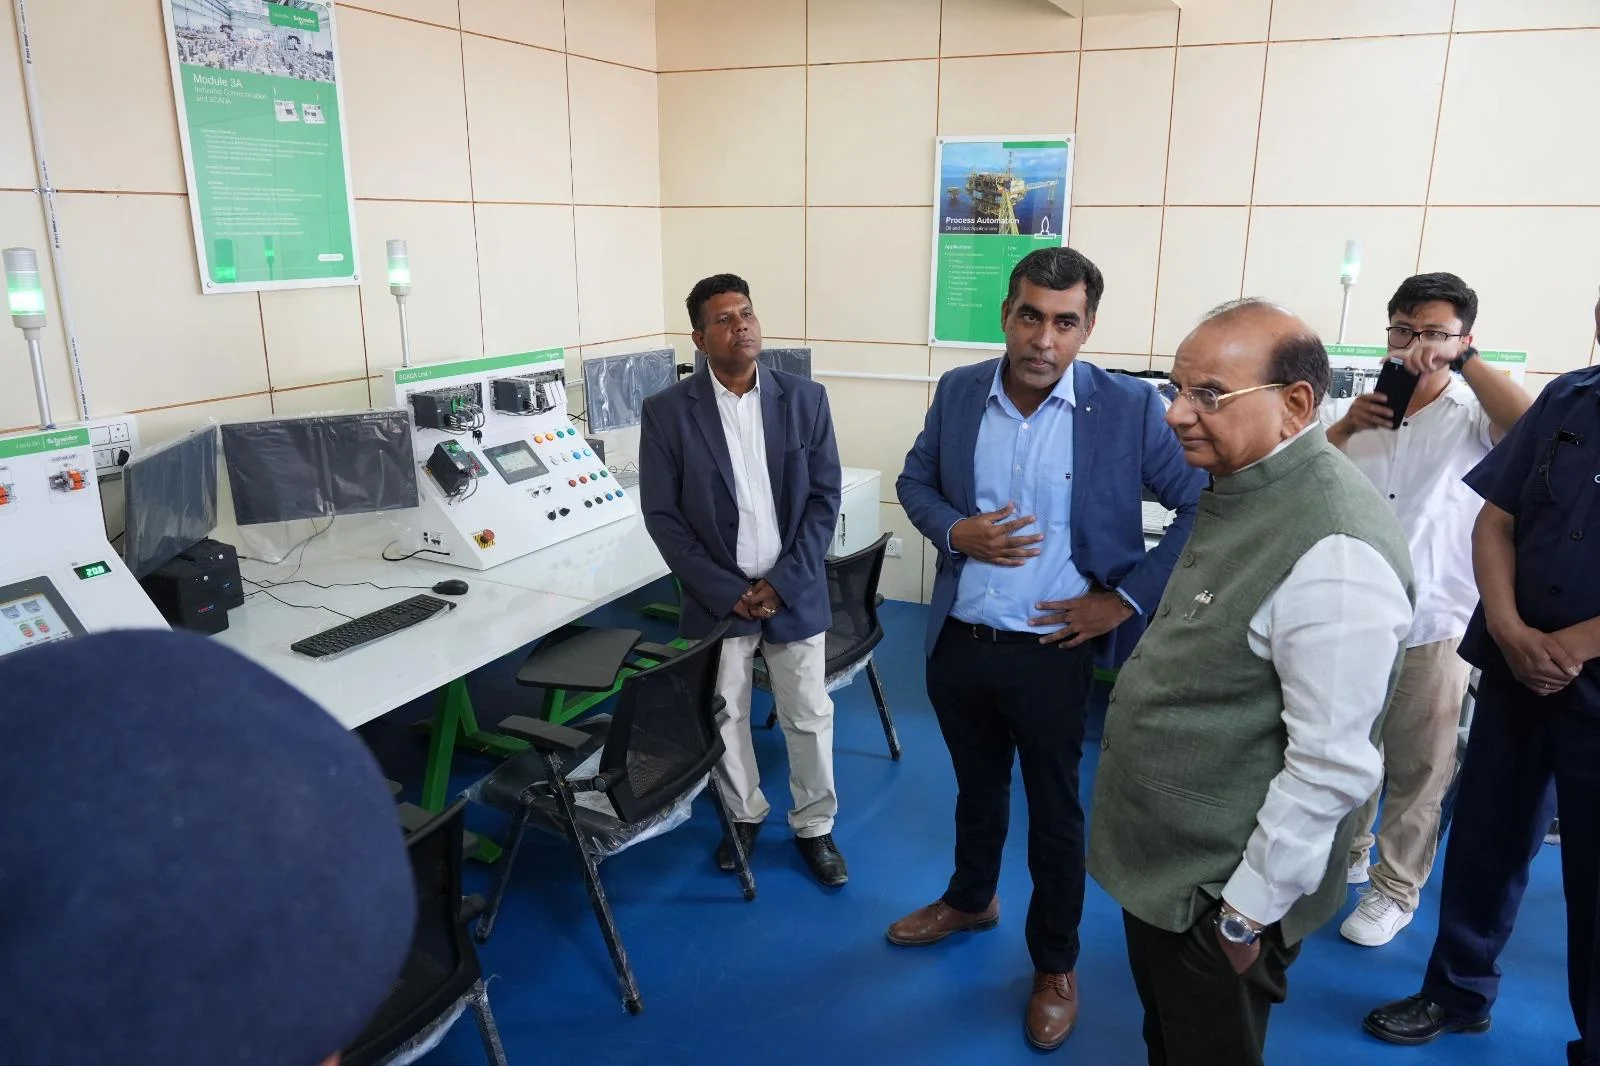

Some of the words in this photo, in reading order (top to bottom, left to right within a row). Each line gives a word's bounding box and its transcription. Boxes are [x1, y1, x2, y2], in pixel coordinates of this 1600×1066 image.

[193, 73, 228, 87] Module
[230, 78, 243, 89] 3A
[945, 216, 976, 225] Process
[976, 216, 1020, 225] Automation
